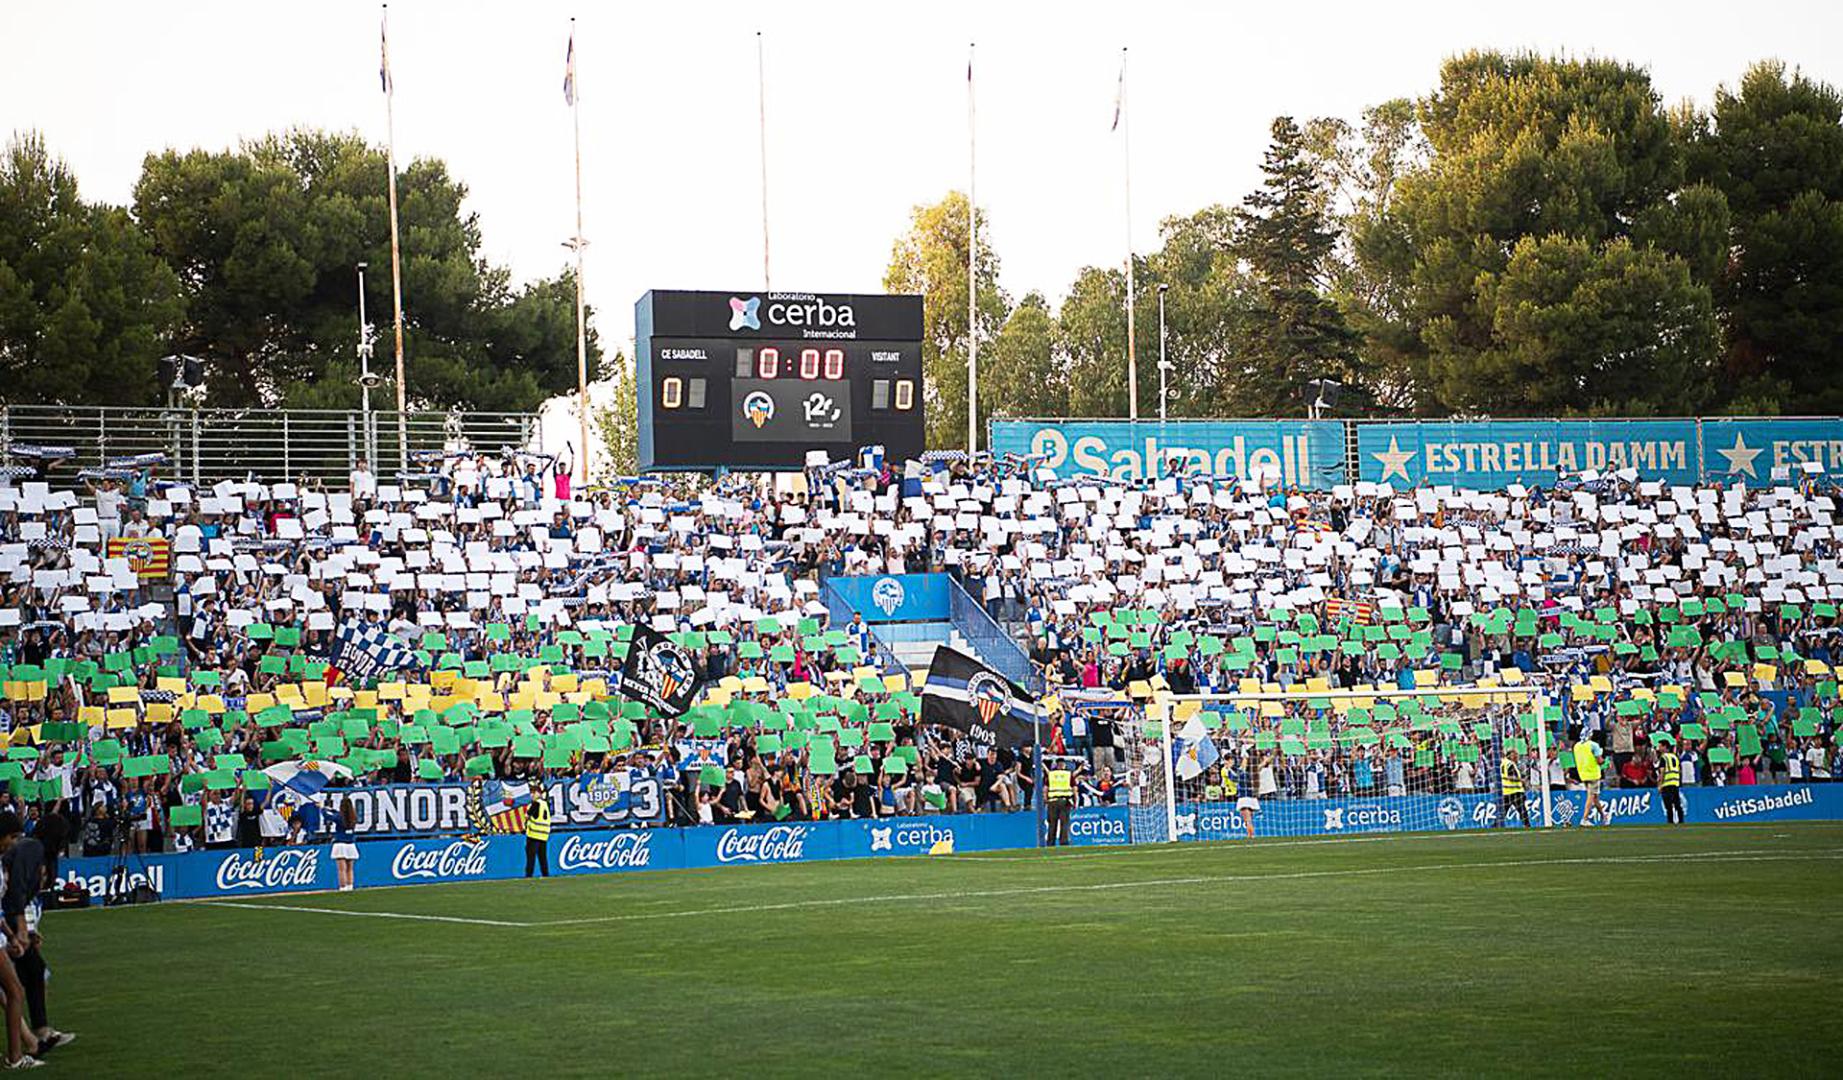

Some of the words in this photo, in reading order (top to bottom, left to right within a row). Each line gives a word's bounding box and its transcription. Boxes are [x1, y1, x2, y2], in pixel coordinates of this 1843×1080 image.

[768, 298, 856, 326] cerba
[803, 329, 856, 339] Internacional
[672, 349, 708, 360] SABADELL
[759, 348, 844, 379] 0:00
[871, 351, 900, 362] VISITANT
[663, 377, 682, 408] 0
[895, 380, 914, 410] 0
[1425, 441, 1578, 473] ESTRELLA
[1585, 440, 1687, 472] DAMM
[970, 724, 996, 746] 1903
[314, 787, 468, 833] HONOR
[588, 790, 618, 801] 1903
[1714, 787, 1813, 819] visitSabadell
[1070, 819, 1125, 836] cerba
[1347, 806, 1401, 825] cerba
[717, 826, 807, 862] Coca-Cola
[897, 825, 954, 846] cerba
[392, 840, 490, 879] Coca-Cola
[559, 832, 653, 870] Coca-Cola
